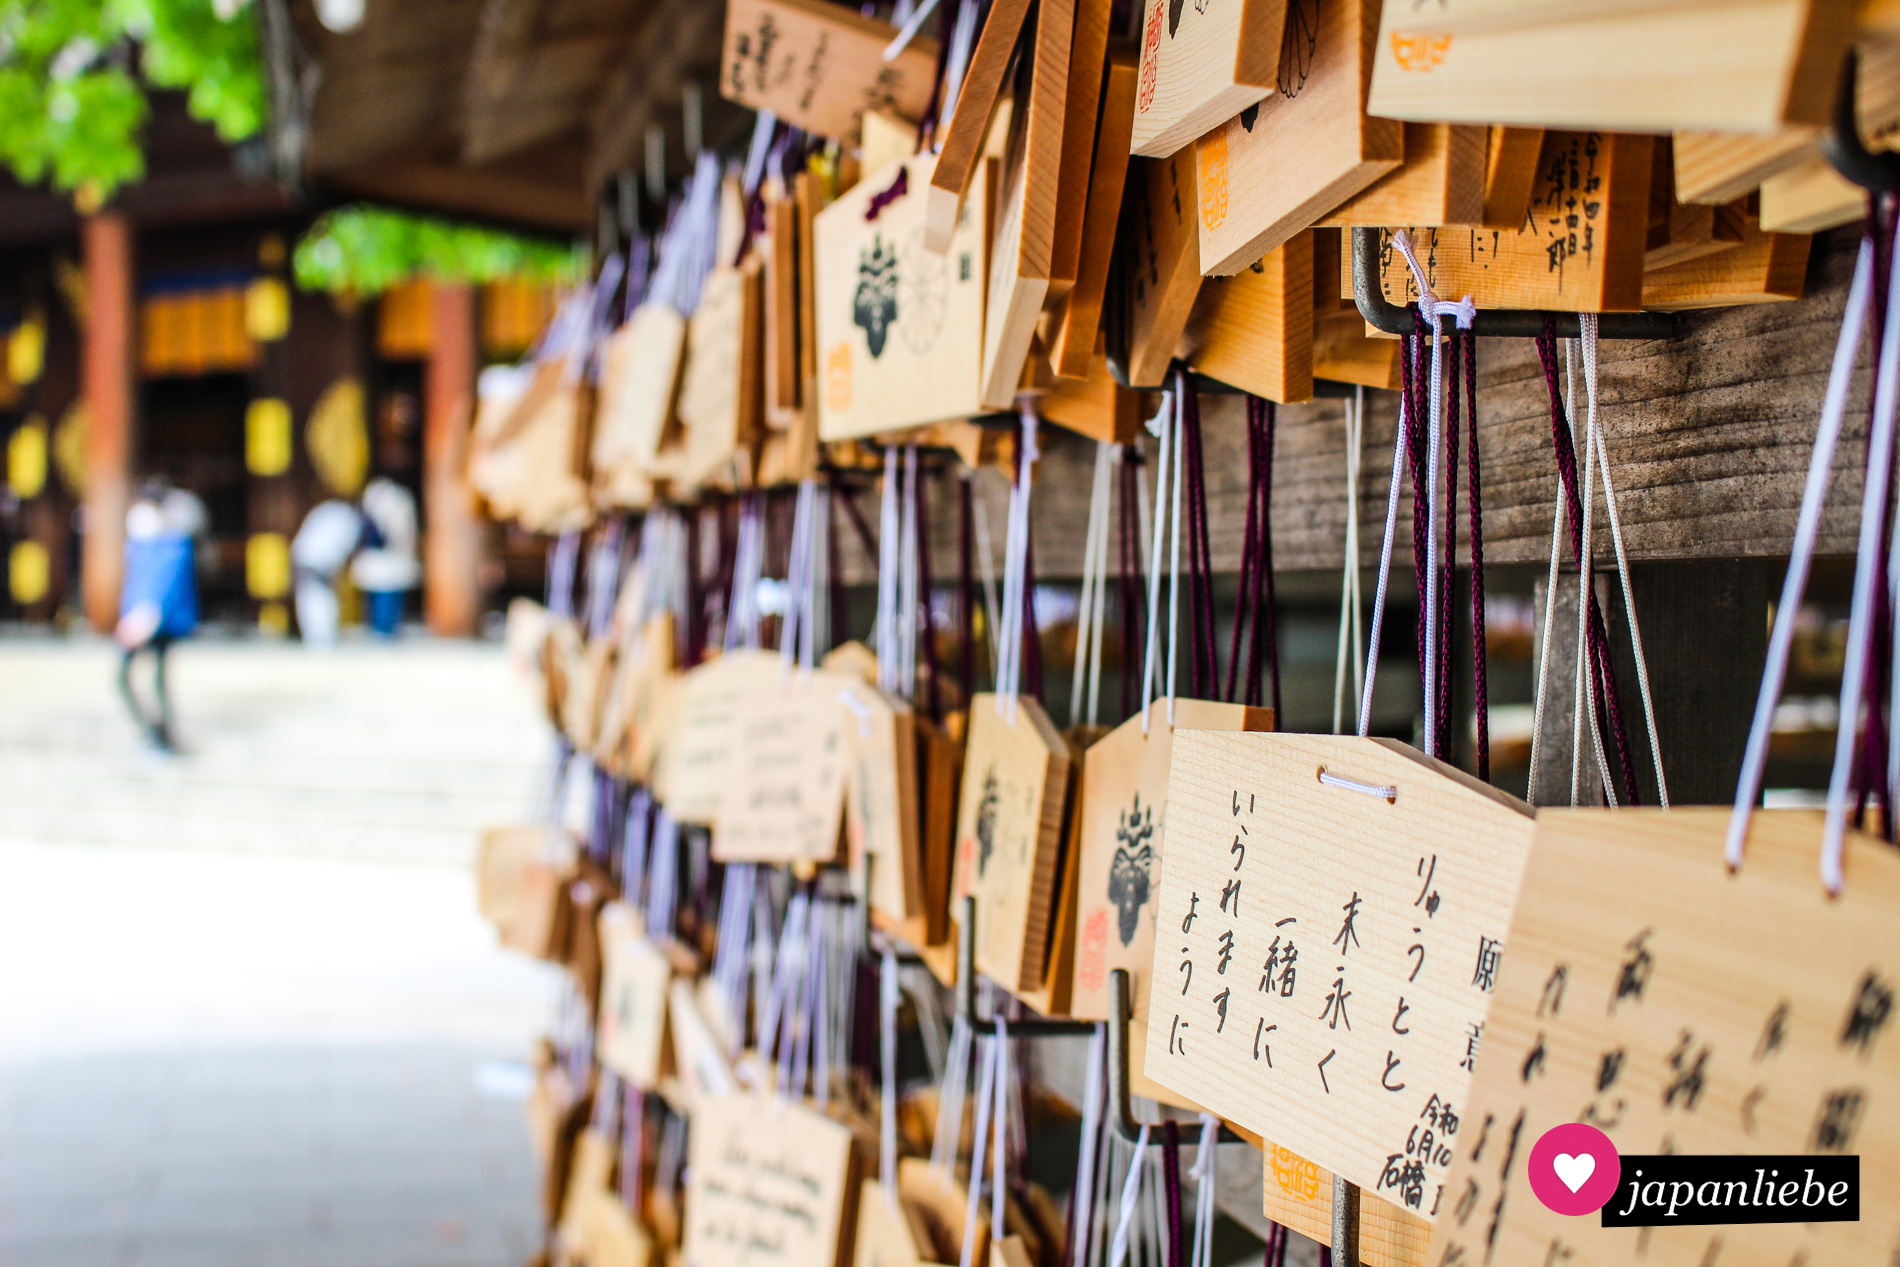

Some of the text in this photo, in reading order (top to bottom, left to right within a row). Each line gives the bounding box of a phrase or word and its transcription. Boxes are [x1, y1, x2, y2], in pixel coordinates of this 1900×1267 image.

[1169, 891, 1200, 1056] ように
[1212, 790, 1255, 1034] いられます
[1253, 917, 1299, 1069] 一緒に
[1318, 891, 1363, 1094] 末永く
[1376, 1152, 1445, 1217] 石橋
